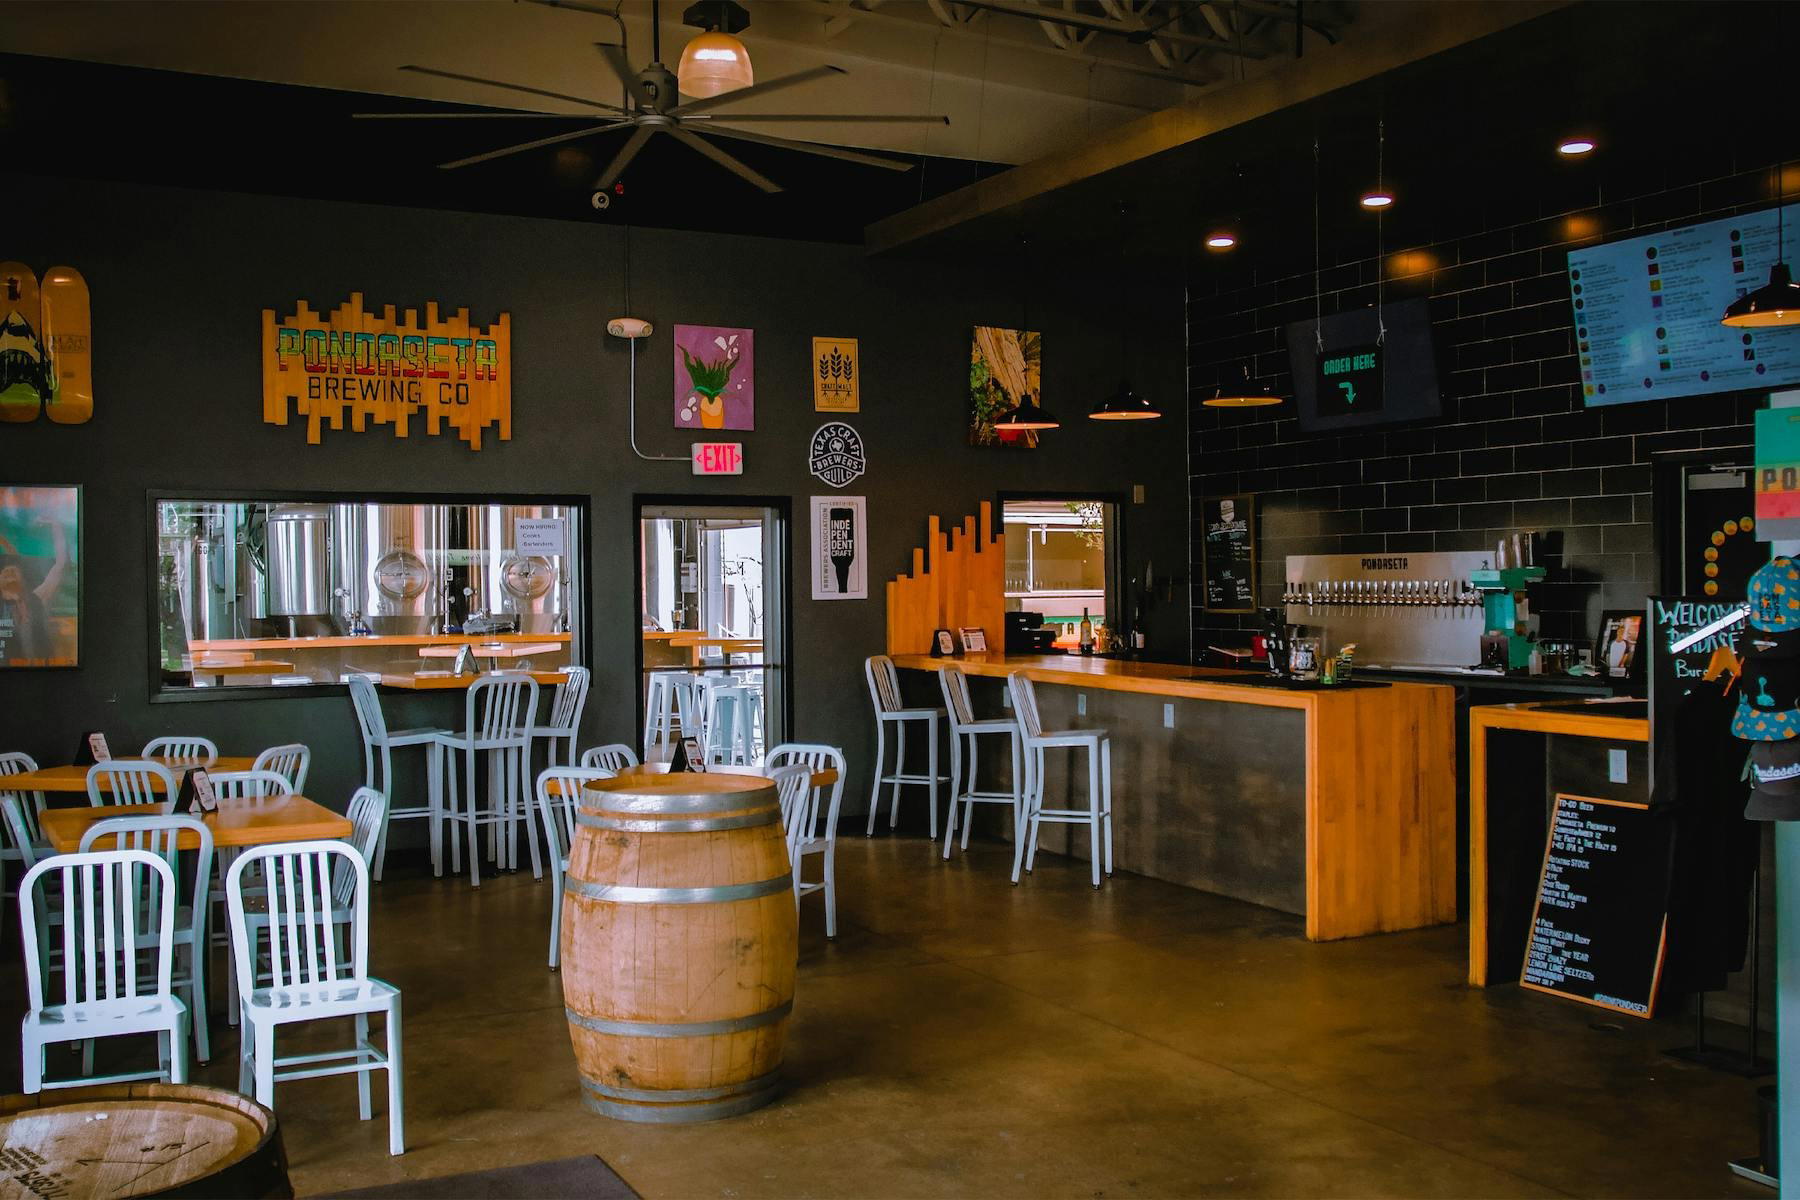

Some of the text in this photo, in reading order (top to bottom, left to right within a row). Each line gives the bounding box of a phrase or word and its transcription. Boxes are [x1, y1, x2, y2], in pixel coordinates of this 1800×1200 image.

[276, 328, 498, 380] PONDASETA
[1324, 352, 1376, 376] ORDER HERE
[308, 376, 469, 404] BREWING CO
[814, 427, 860, 457] TEXAS CRAFT
[703, 445, 736, 472] EXIT
[815, 454, 858, 470] BREWERS
[823, 467, 852, 483] GUILD
[831, 520, 850, 530] INDE
[831, 530, 848, 540] PEN
[831, 540, 853, 549] DENT
[1361, 557, 1408, 570] PONDASETA
